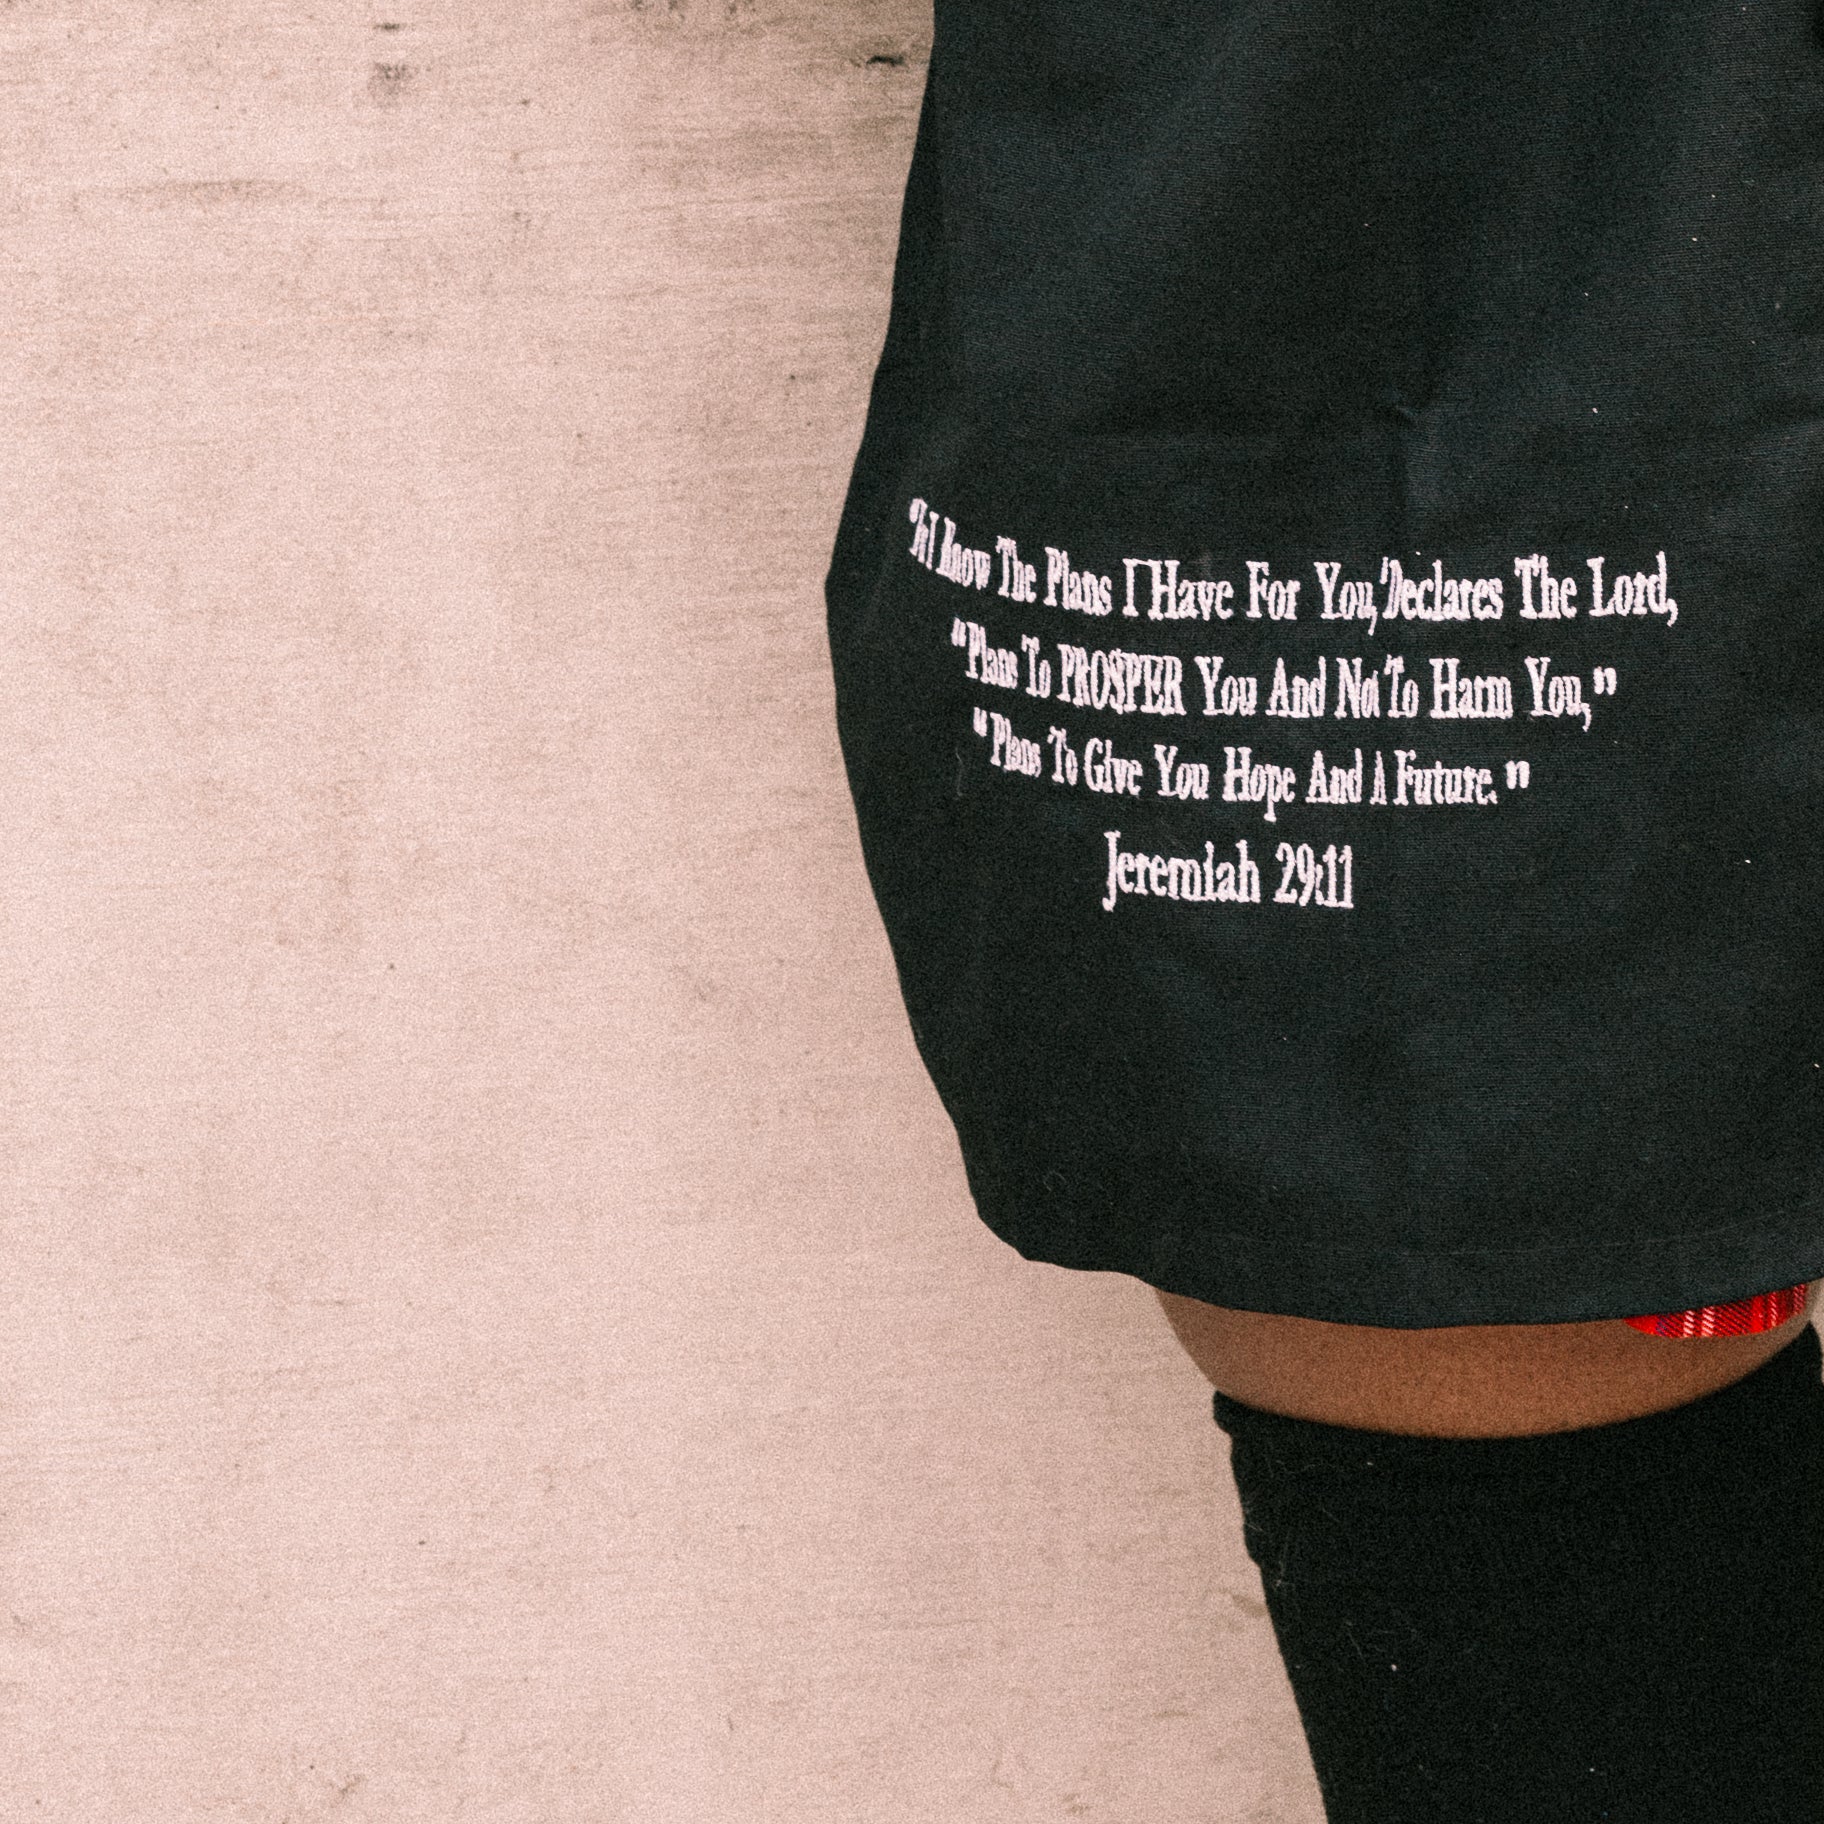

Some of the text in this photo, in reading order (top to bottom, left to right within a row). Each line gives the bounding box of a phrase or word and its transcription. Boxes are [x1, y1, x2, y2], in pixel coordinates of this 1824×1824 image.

[995, 536, 1037, 603] The
[1043, 547, 1113, 616] Plans
[1122, 558, 1140, 617] I
[1147, 558, 1234, 621] Have
[1246, 561, 1300, 620] For
[1514, 553, 1577, 619] The
[1586, 551, 1678, 627] Lord,
[951, 617, 1018, 690] "Plans
[1021, 634, 1051, 698] To
[1057, 644, 1187, 716] PROSPER
[1194, 656, 1257, 716] You
[1265, 656, 1327, 718] And
[1384, 654, 1419, 718] To
[1429, 658, 1513, 719] Harm
[1524, 656, 1617, 732] You,"
[1047, 726, 1078, 786] To
[1083, 738, 1143, 796] Give
[1154, 744, 1209, 800] You
[1222, 747, 1296, 823] Hope
[1305, 748, 1363, 804] And
[1369, 751, 1387, 805] A
[1102, 830, 1354, 911] Jeremiah 29:11
